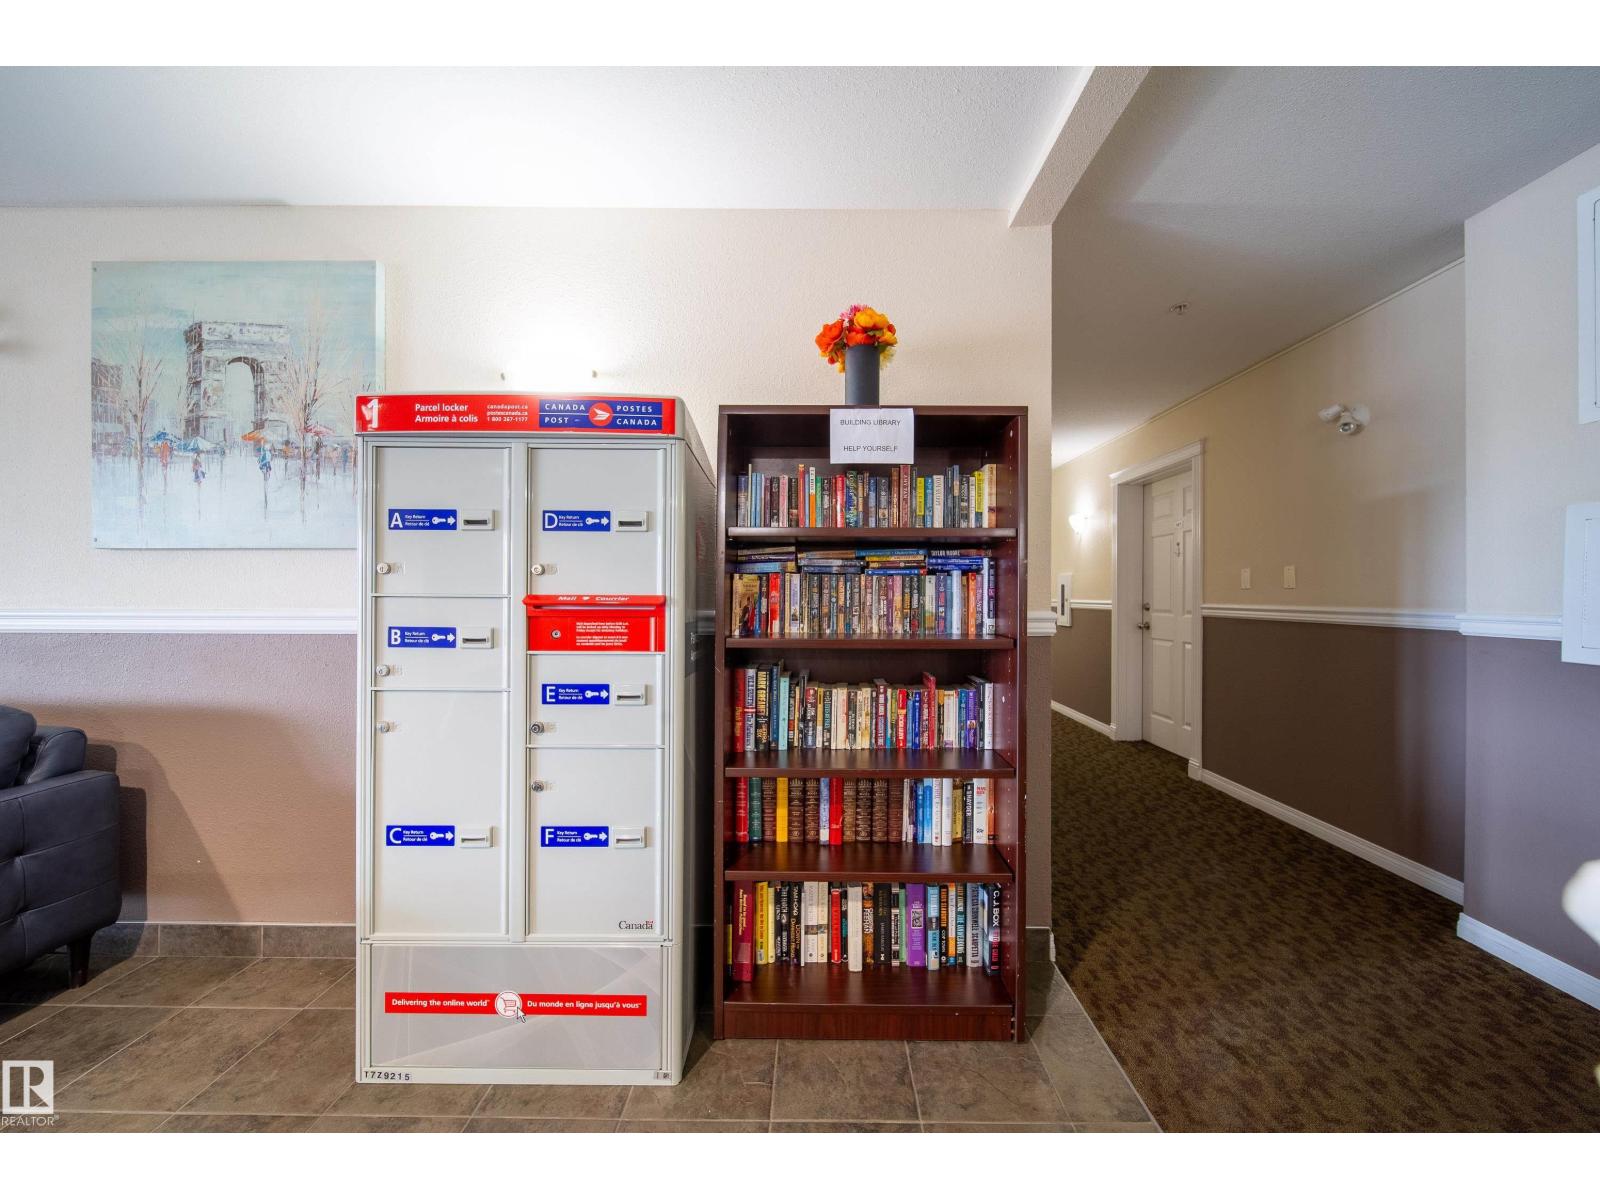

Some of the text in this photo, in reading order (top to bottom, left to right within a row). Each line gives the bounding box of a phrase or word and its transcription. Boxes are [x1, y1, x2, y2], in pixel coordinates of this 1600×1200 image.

[415, 403, 469, 412] Parcel locker
[545, 403, 586, 412] CANADA
[616, 404, 653, 413] POSTES
[415, 414, 479, 423] Armoire à colis
[545, 416, 569, 424] POST
[616, 418, 657, 426] CANADA
[840, 419, 901, 427] BUILDING LIBRARY
[843, 445, 898, 453] HELP YOURSELF
[390, 512, 404, 529] A
[545, 512, 558, 529] D
[390, 628, 402, 645] B
[546, 686, 556, 702] E
[389, 827, 402, 845] C
[545, 828, 555, 845] F
[618, 919, 654, 930] Canada
[391, 998, 488, 1009] Delivering the online world
[527, 1000, 639, 1011] Du monde en ligne jusqu'à vous
